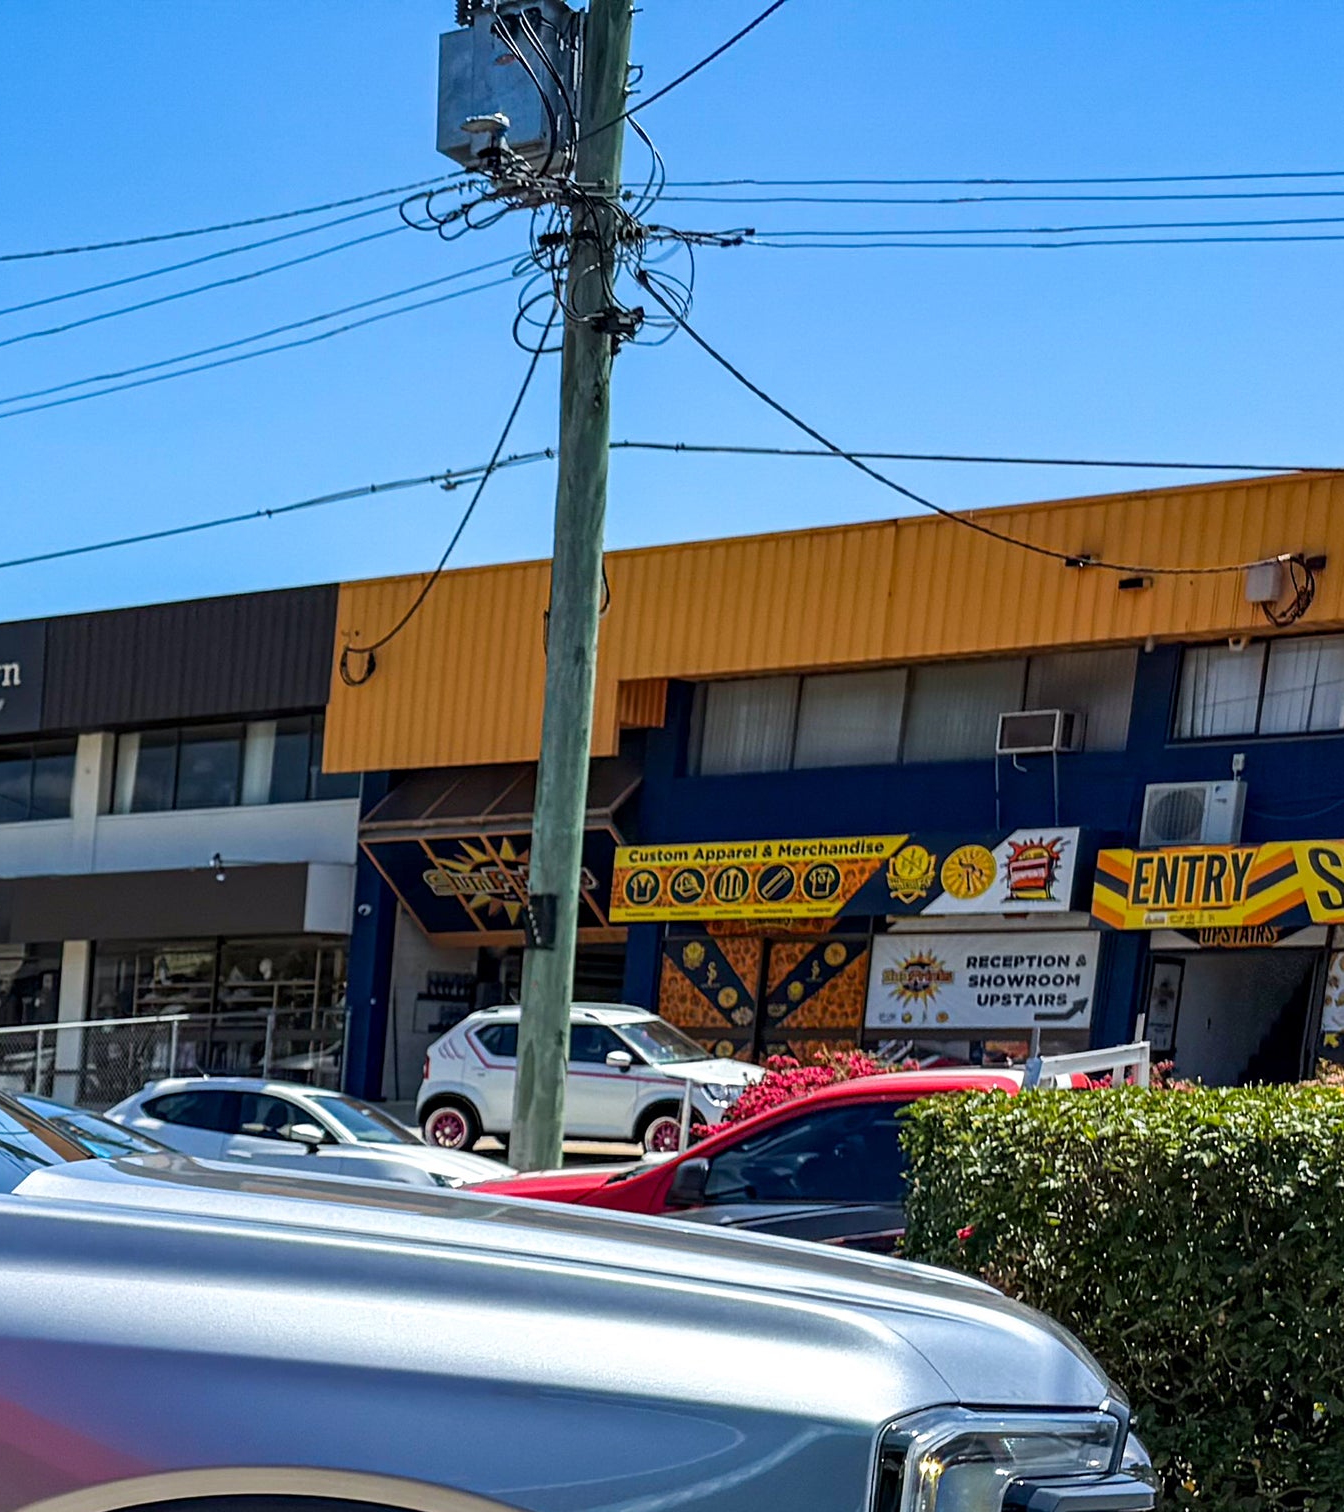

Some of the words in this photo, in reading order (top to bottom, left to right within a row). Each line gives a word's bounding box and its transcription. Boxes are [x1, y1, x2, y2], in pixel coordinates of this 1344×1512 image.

[628, 849, 688, 863] Custom
[694, 844, 758, 861] Apparel
[762, 842, 773, 857] &
[776, 838, 885, 858] Merchandise
[1131, 852, 1254, 905] ENTRY
[966, 955, 1071, 969] RECEPTION
[1076, 953, 1087, 967] &
[968, 973, 1081, 988] SHOWROOM
[977, 993, 1068, 1007] UPSTAIRS
